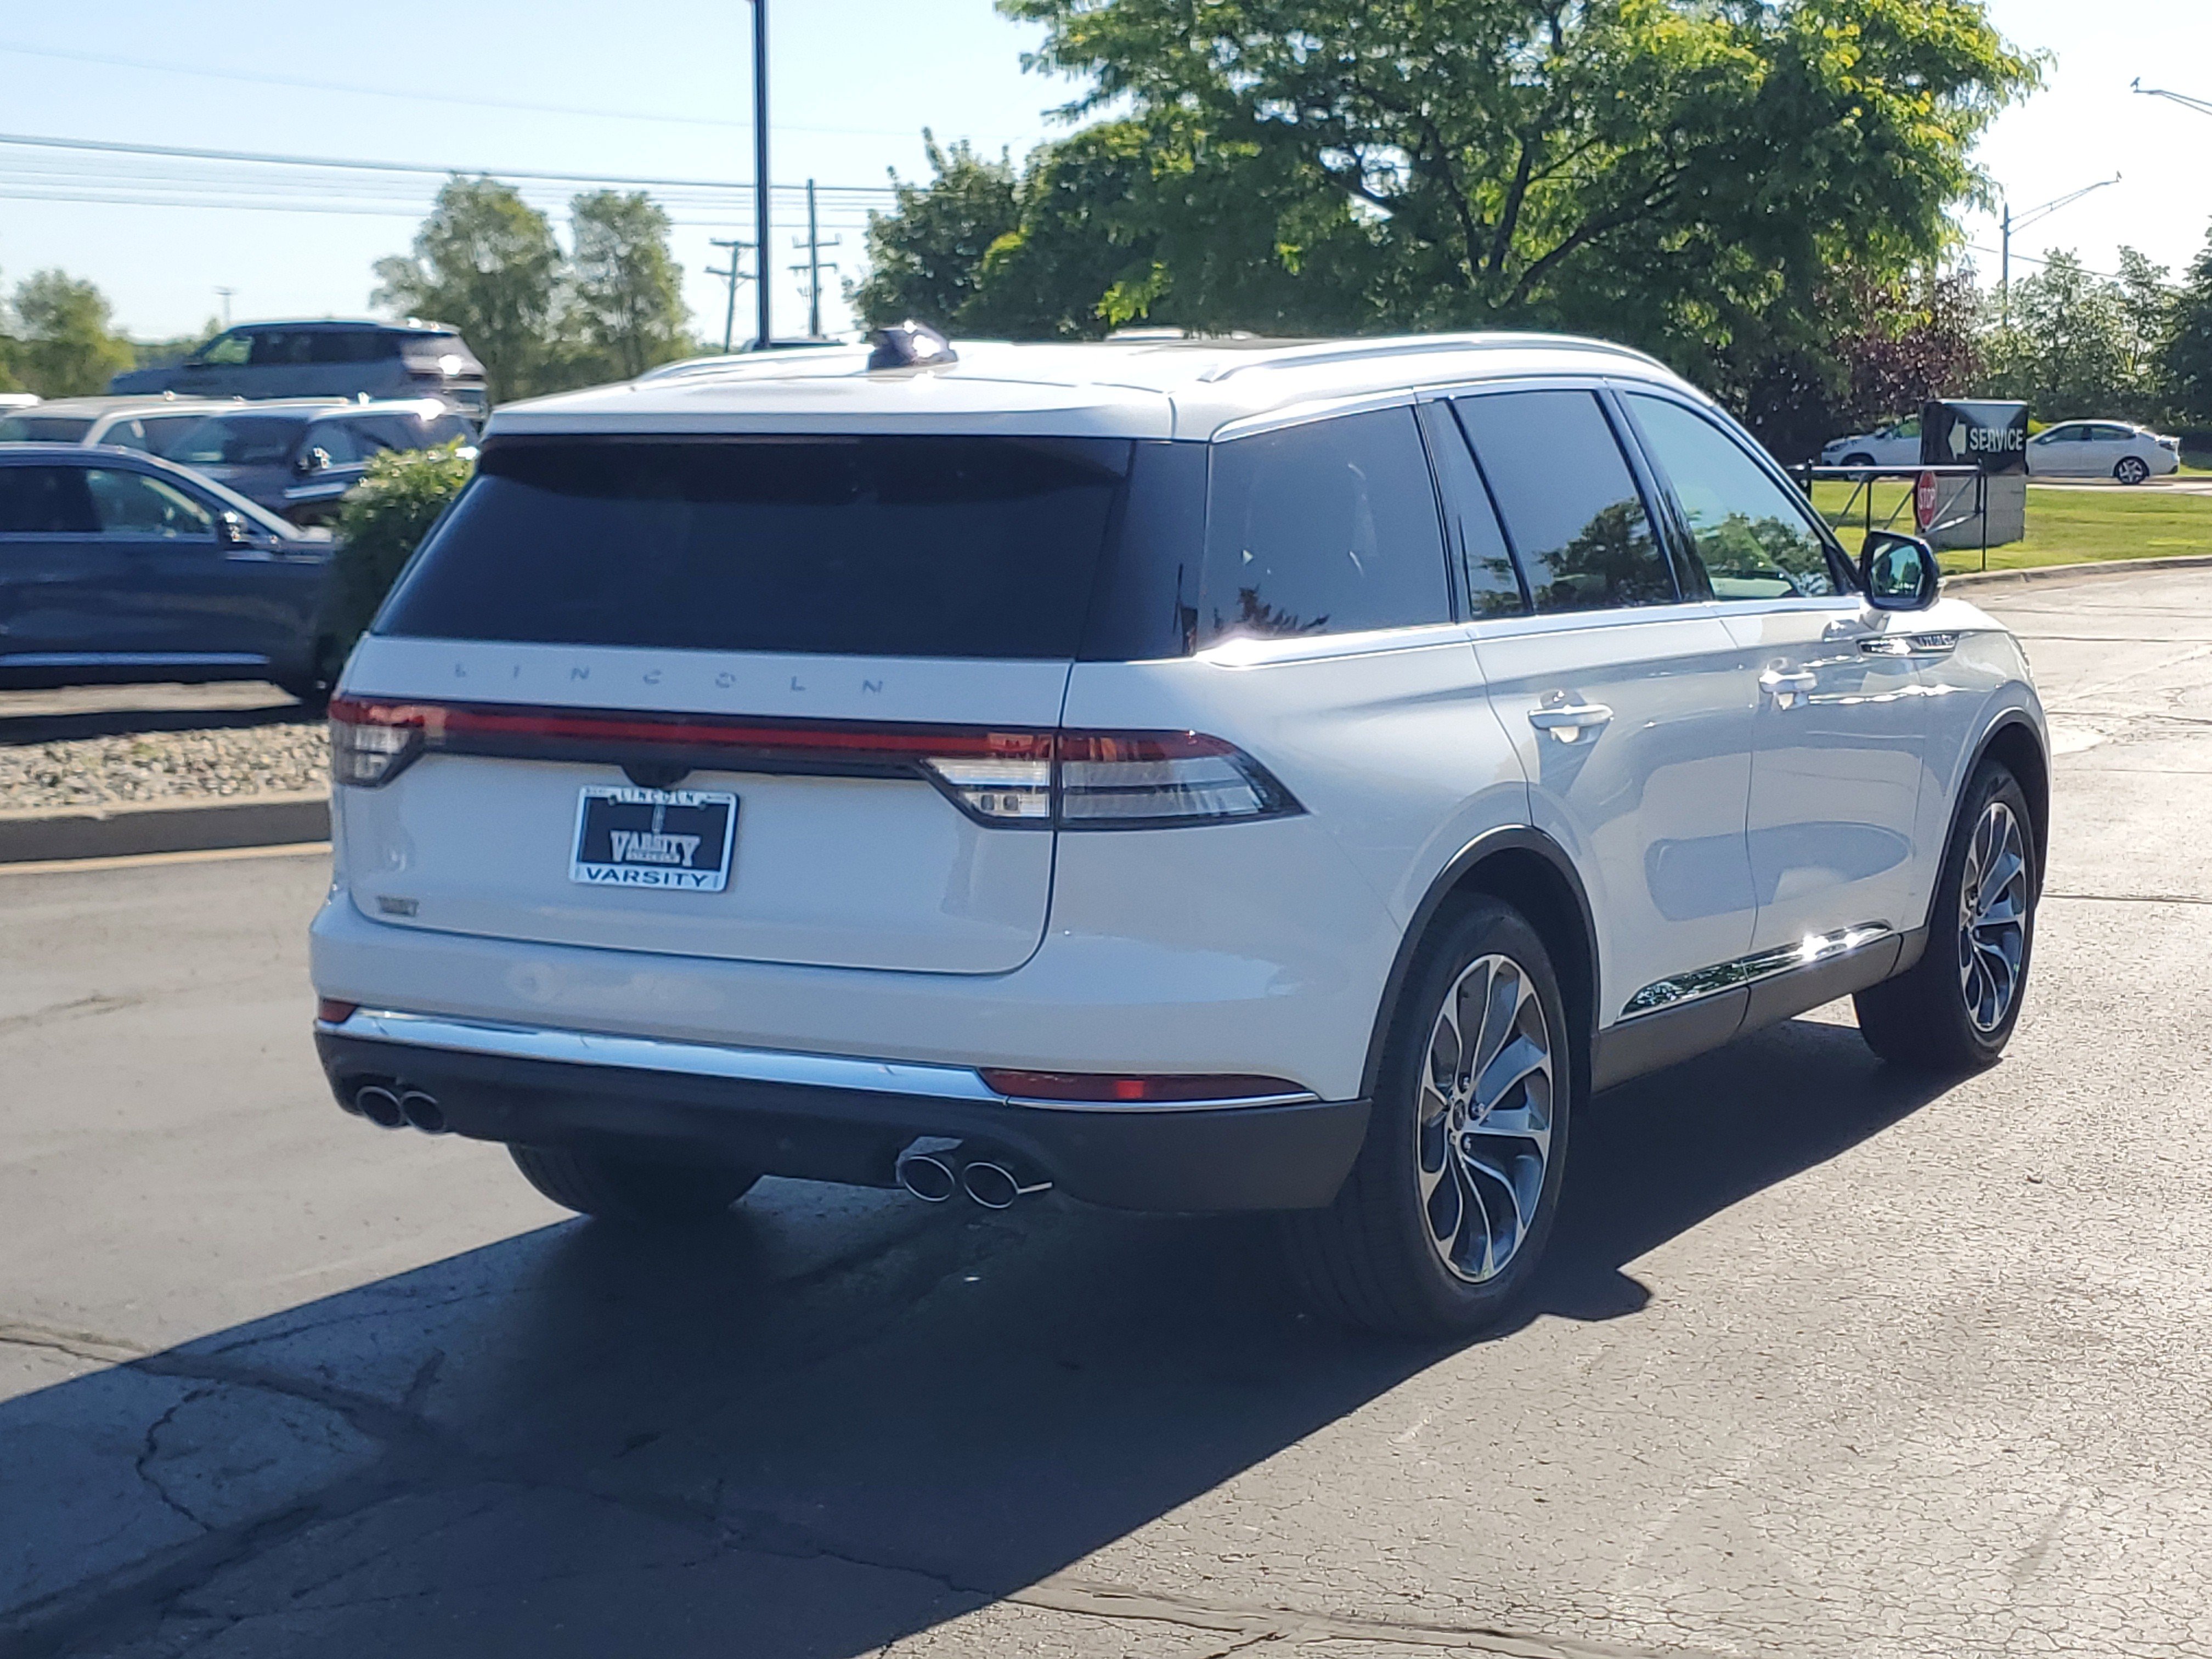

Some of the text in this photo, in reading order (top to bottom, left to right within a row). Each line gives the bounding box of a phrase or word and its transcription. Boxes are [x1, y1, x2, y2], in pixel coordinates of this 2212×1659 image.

[1970, 427, 2023, 453] SERVICE
[1919, 488, 1936, 510] STOP
[455, 664, 883, 693] LINCOLN
[586, 867, 708, 887] VARSITY
